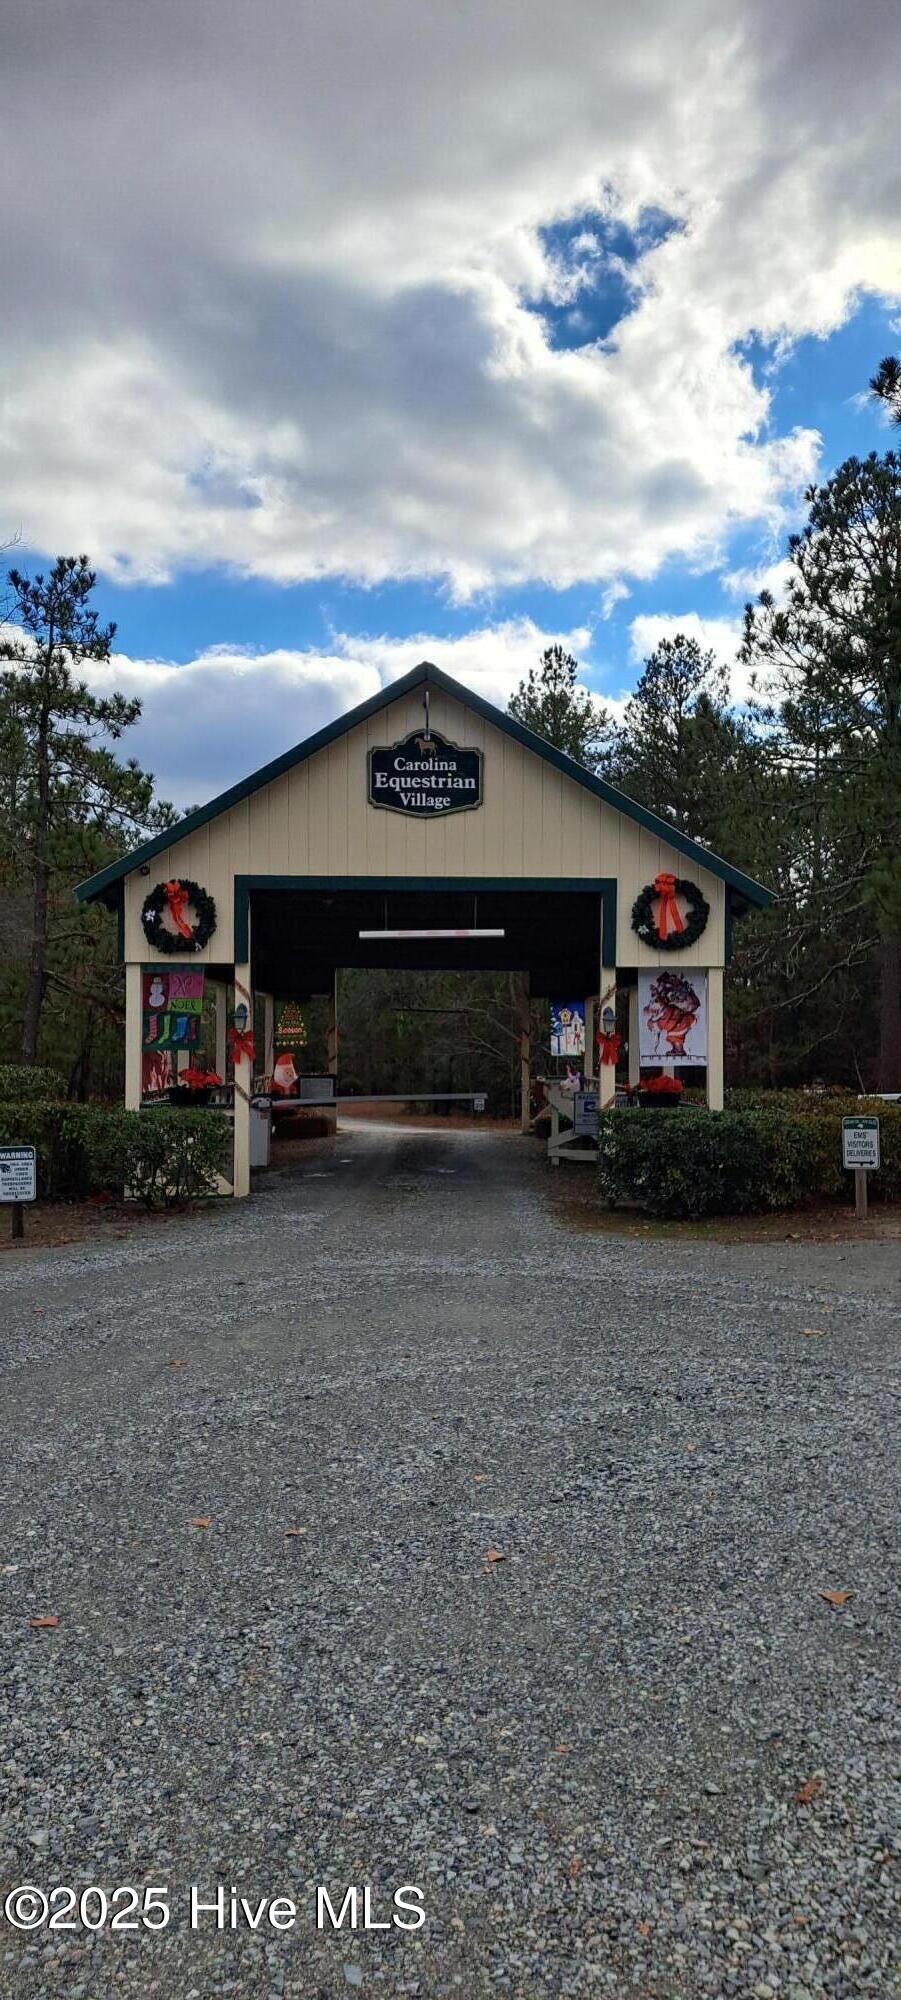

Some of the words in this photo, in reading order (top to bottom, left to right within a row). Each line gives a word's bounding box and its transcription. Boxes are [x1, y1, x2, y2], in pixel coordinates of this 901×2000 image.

[393, 757, 457, 771] Carolina
[374, 771, 476, 792] Equestrian
[400, 792, 451, 810] Village
[853, 1131, 867, 1139] EMS
[847, 1140, 874, 1149] VISITORS
[0, 1151, 33, 1160] WARNING
[846, 1149, 877, 1157] DELIVERIES
